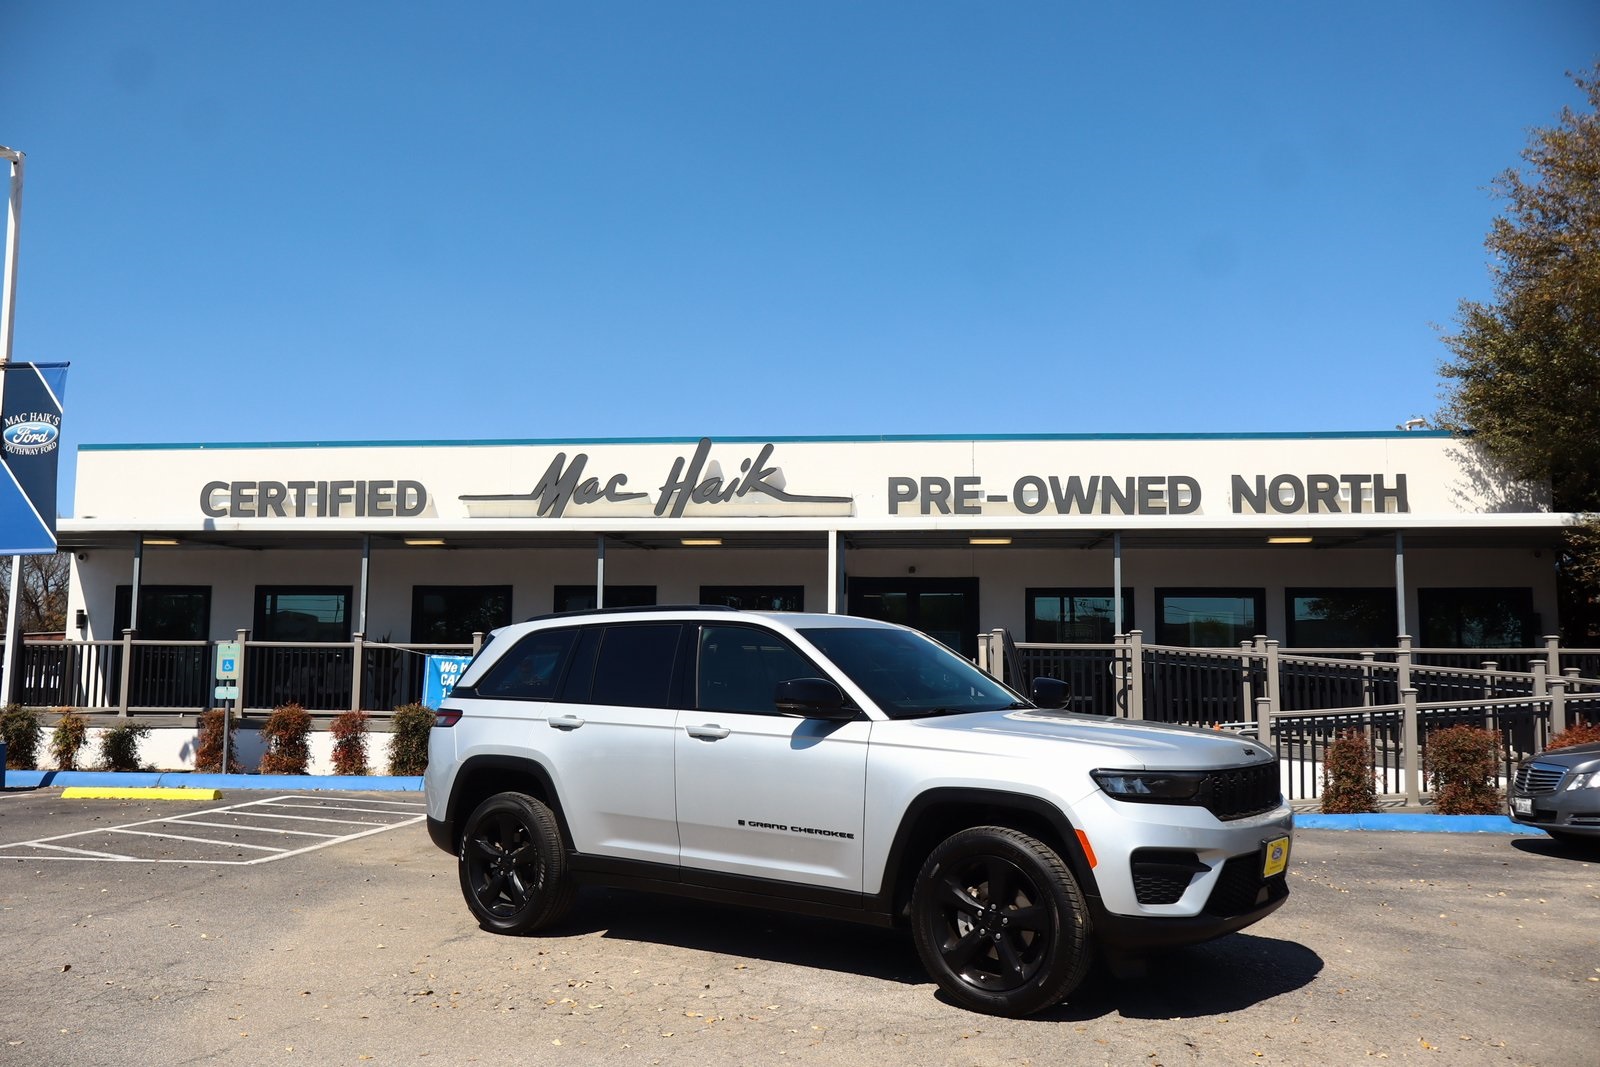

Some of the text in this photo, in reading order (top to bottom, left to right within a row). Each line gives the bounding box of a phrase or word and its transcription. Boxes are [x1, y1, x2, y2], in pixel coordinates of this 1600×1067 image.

[5, 412, 60, 427] MAC HAIK'S
[13, 426, 49, 443] Ford
[40, 441, 57, 454] FORD
[458, 437, 853, 518] Mac Haik
[200, 480, 427, 518] CERTIFIED
[887, 473, 1408, 515] PRE-OWNED NORTH
[440, 661, 458, 673] We
[748, 821, 854, 839] GRAND CHEROKEE
